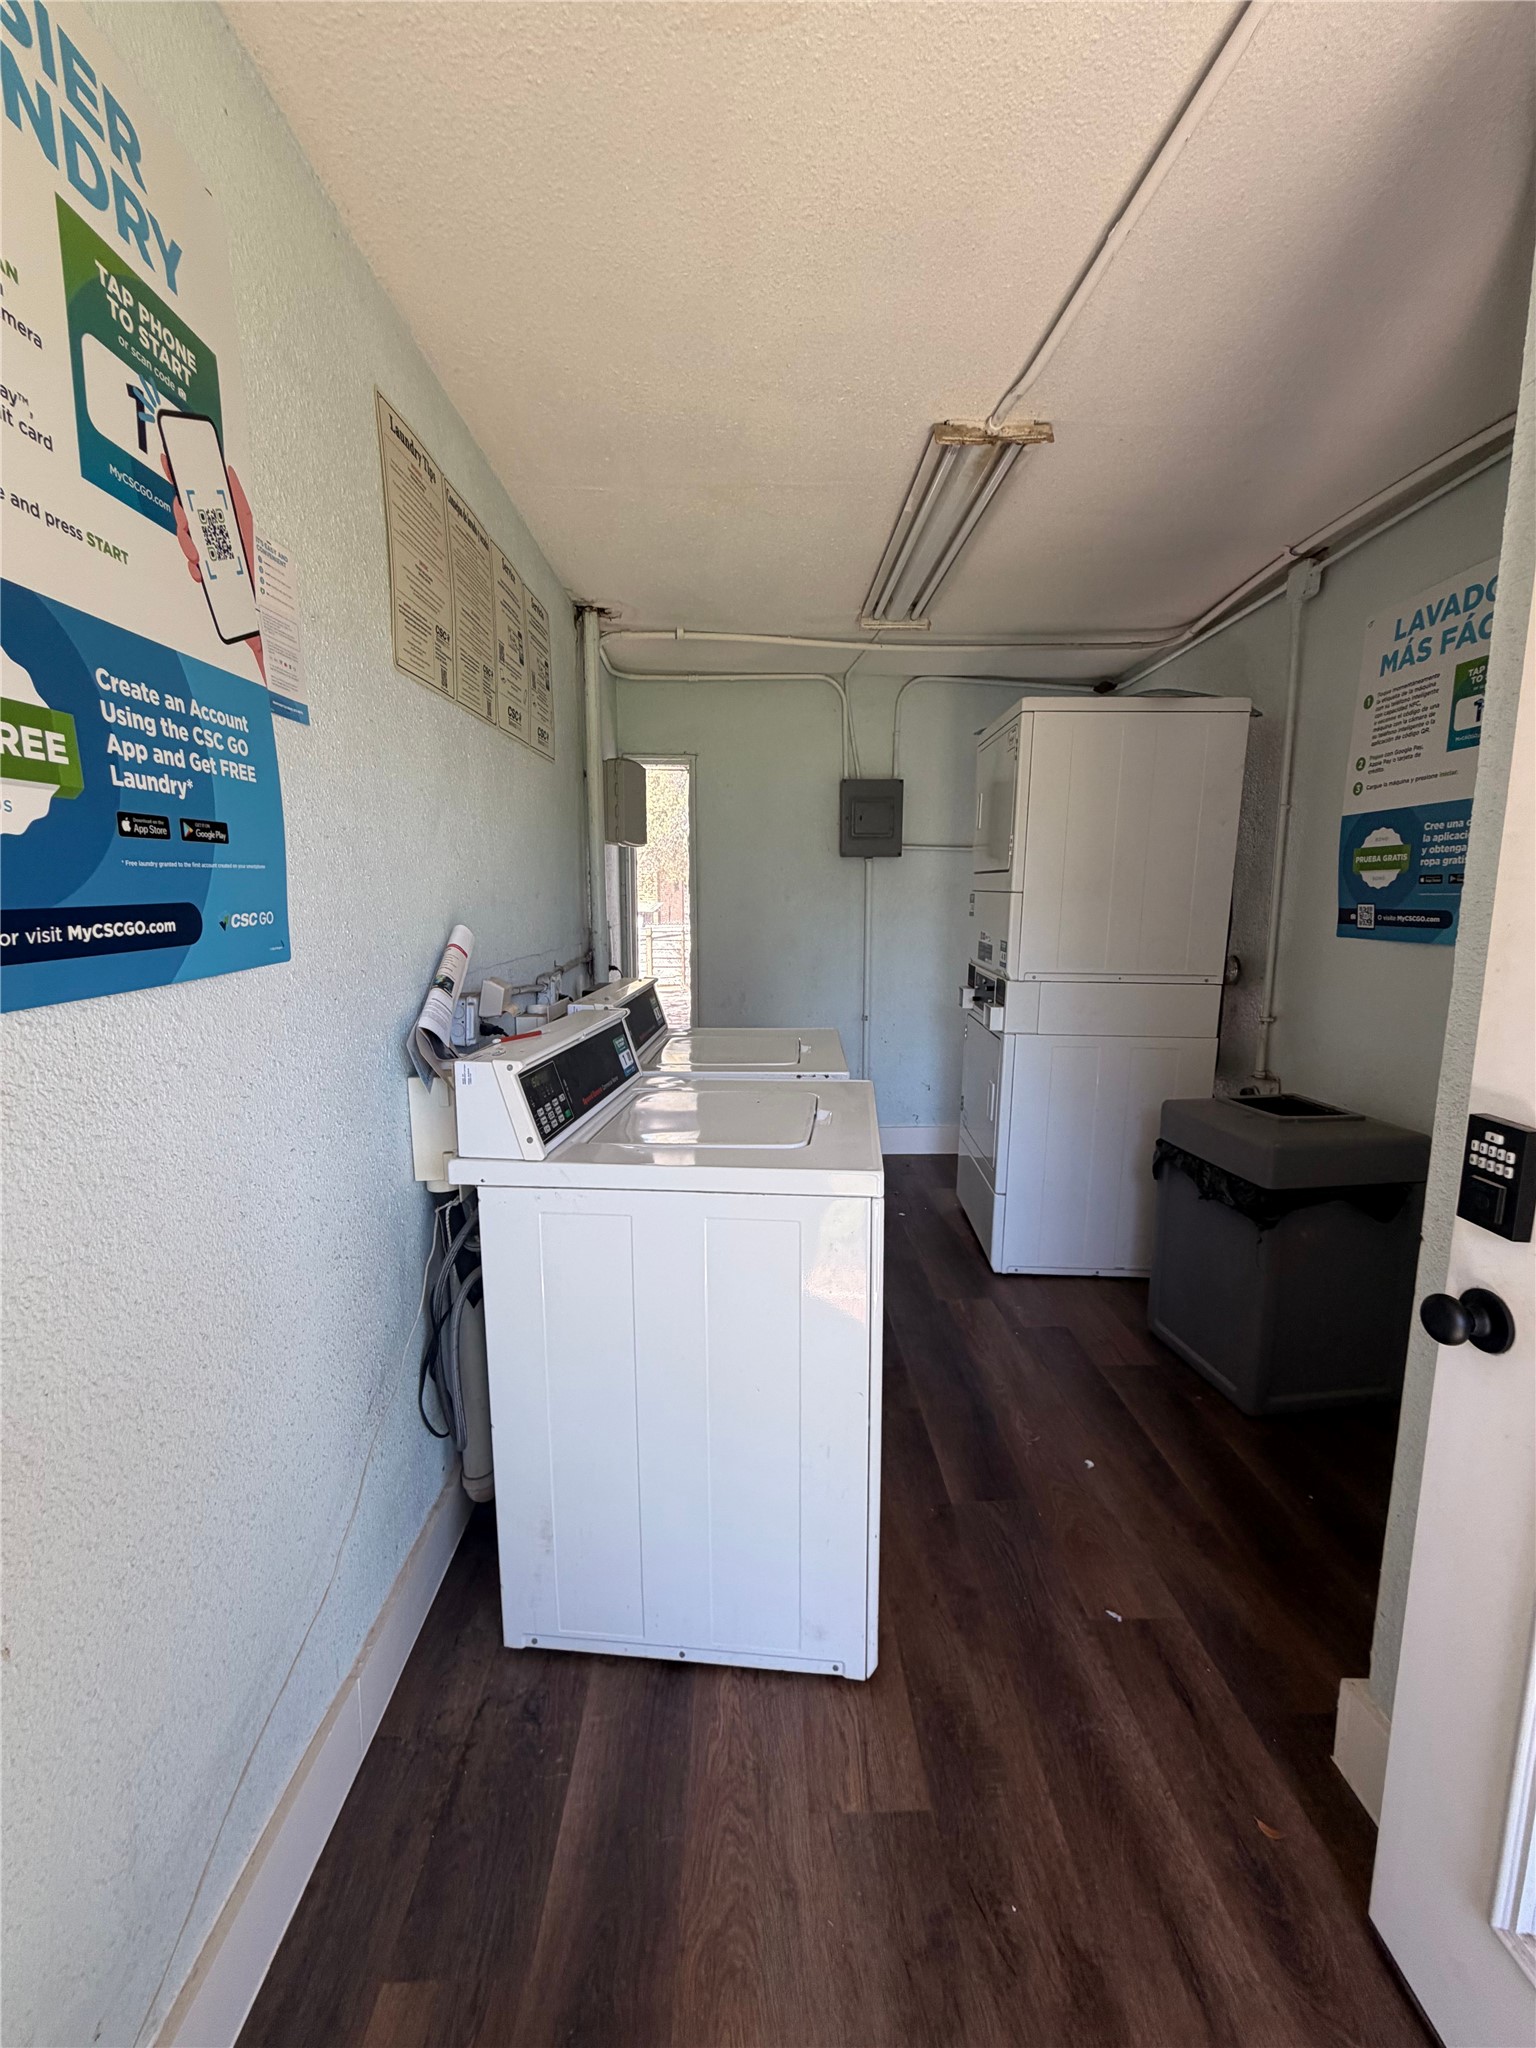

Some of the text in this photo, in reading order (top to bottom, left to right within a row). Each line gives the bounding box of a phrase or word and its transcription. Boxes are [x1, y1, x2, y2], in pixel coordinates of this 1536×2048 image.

[0, 39, 183, 297] NDRY
[94, 259, 198, 374] TAP PHONE
[1, 307, 42, 350] mera
[106, 293, 191, 387] TO START
[118, 336, 175, 391] or scan code
[0, 404, 54, 452] it card
[109, 464, 172, 513] MyCSCGO.com
[10, 493, 40, 519] and
[45, 511, 83, 541] press
[86, 531, 128, 565] START
[1379, 611, 1494, 677] MÁS FÁC
[1468, 665, 1486, 677] TAP
[1471, 674, 1483, 685] TO
[95, 667, 160, 706] Create
[164, 692, 186, 714] an
[189, 698, 250, 733] Account
[100, 699, 249, 757] Using the CSC GO
[0, 721, 70, 765] REE
[1394, 747, 1413, 755] Google
[106, 733, 257, 784] App and Get FREE
[1414, 773, 1438, 782] presione
[133, 824, 168, 836] App Store
[195, 829, 227, 842] Google Play
[1422, 830, 1470, 843] la aplicaci
[1424, 822, 1445, 831] Cree
[1446, 820, 1464, 829] una
[1355, 853, 1408, 864] PRUEBA GRATIS
[1421, 844, 1467, 856] y obtenga
[138, 860, 158, 869] laundry
[1420, 858, 1440, 867] ropa
[231, 911, 274, 928] CSC GO
[1396, 915, 1441, 923] MyCSCGO.com
[0, 920, 177, 947] or visit MyCSCGO.com
